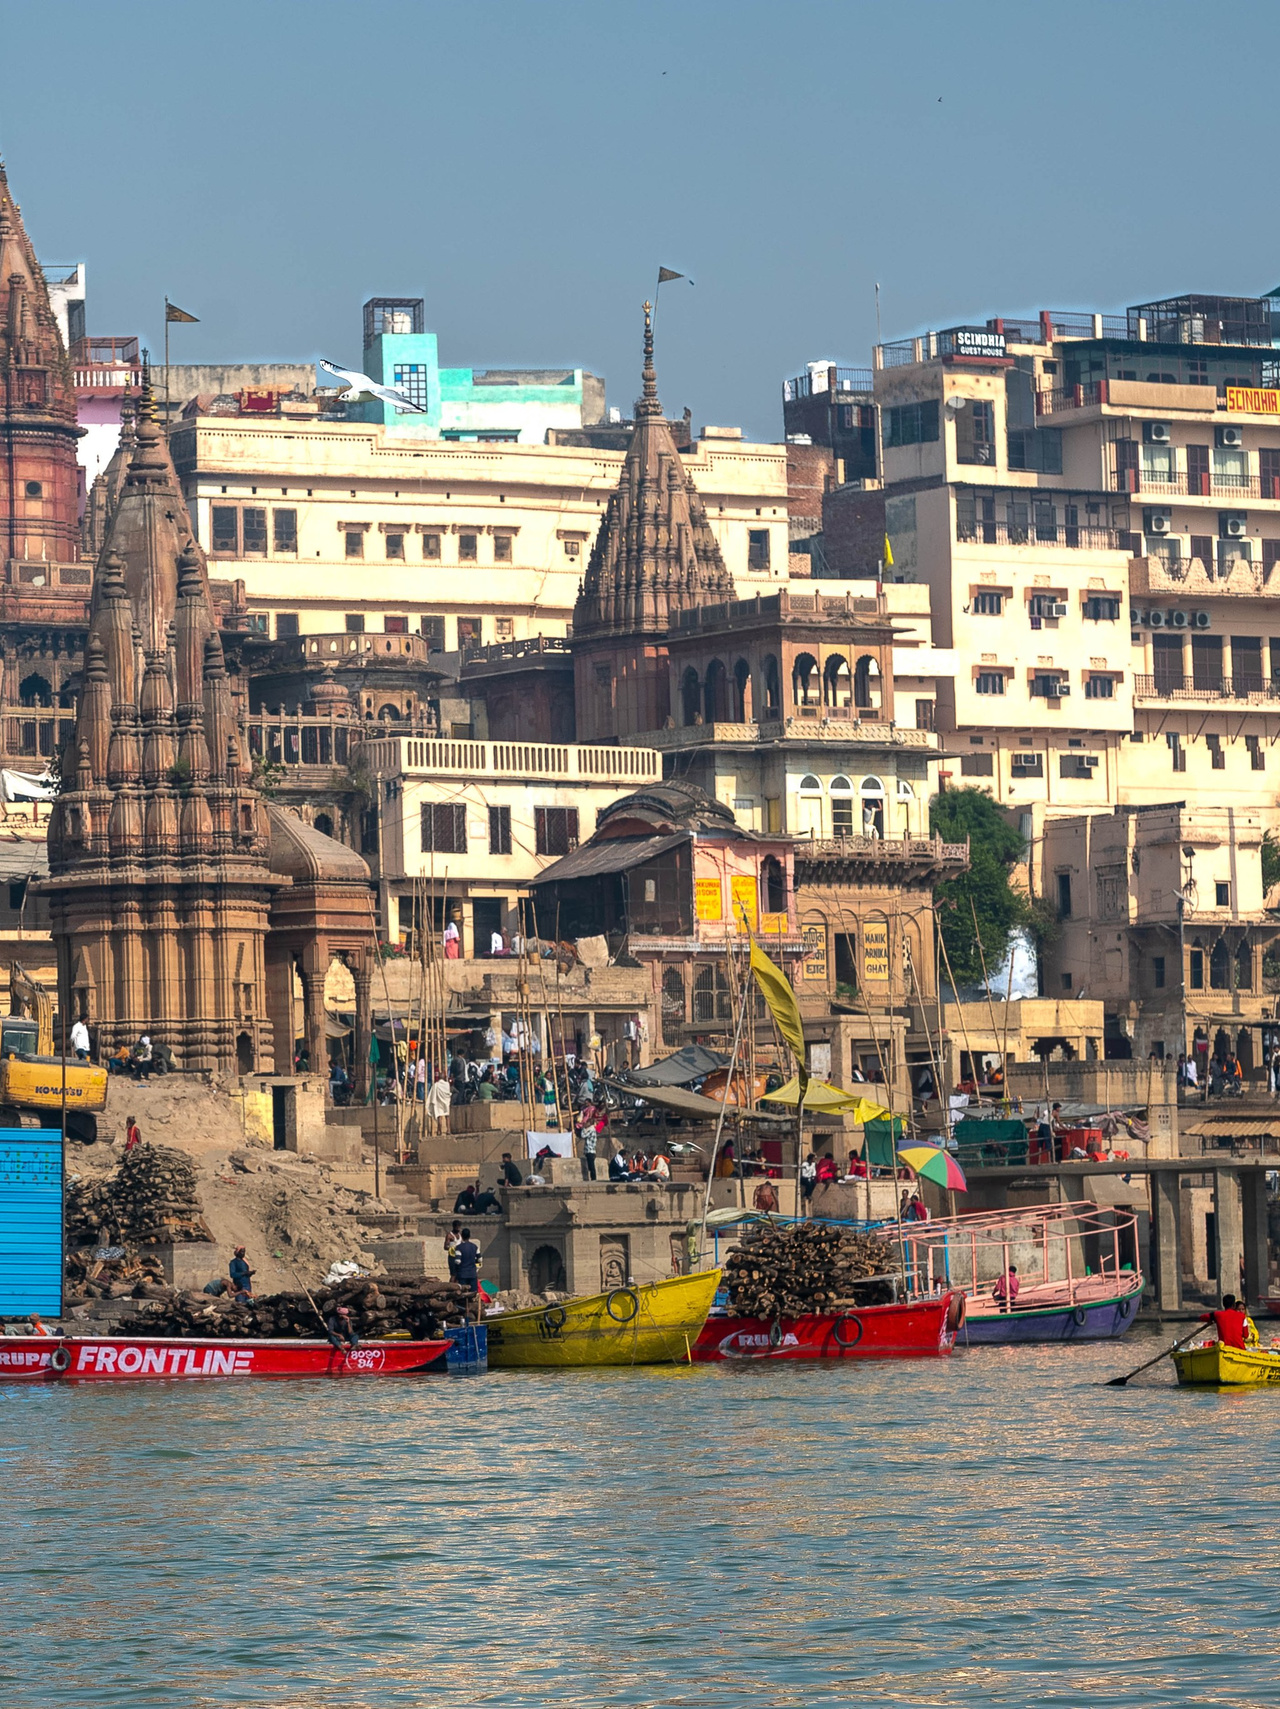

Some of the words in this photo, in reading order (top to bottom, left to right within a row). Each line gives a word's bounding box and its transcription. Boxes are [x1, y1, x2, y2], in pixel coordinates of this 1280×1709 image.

[957, 332, 1006, 348] SCINDHIA
[960, 346, 982, 355] GUEST
[982, 347, 1004, 357] HOUSE
[1228, 389, 1278, 412] SCINDHIA
[864, 932, 886, 944] MANIK
[864, 947, 888, 958] ARNIKA
[866, 964, 887, 973] GHAT
[738, 1332, 800, 1346] RUA
[76, 1345, 255, 1376] FRONTLINE
